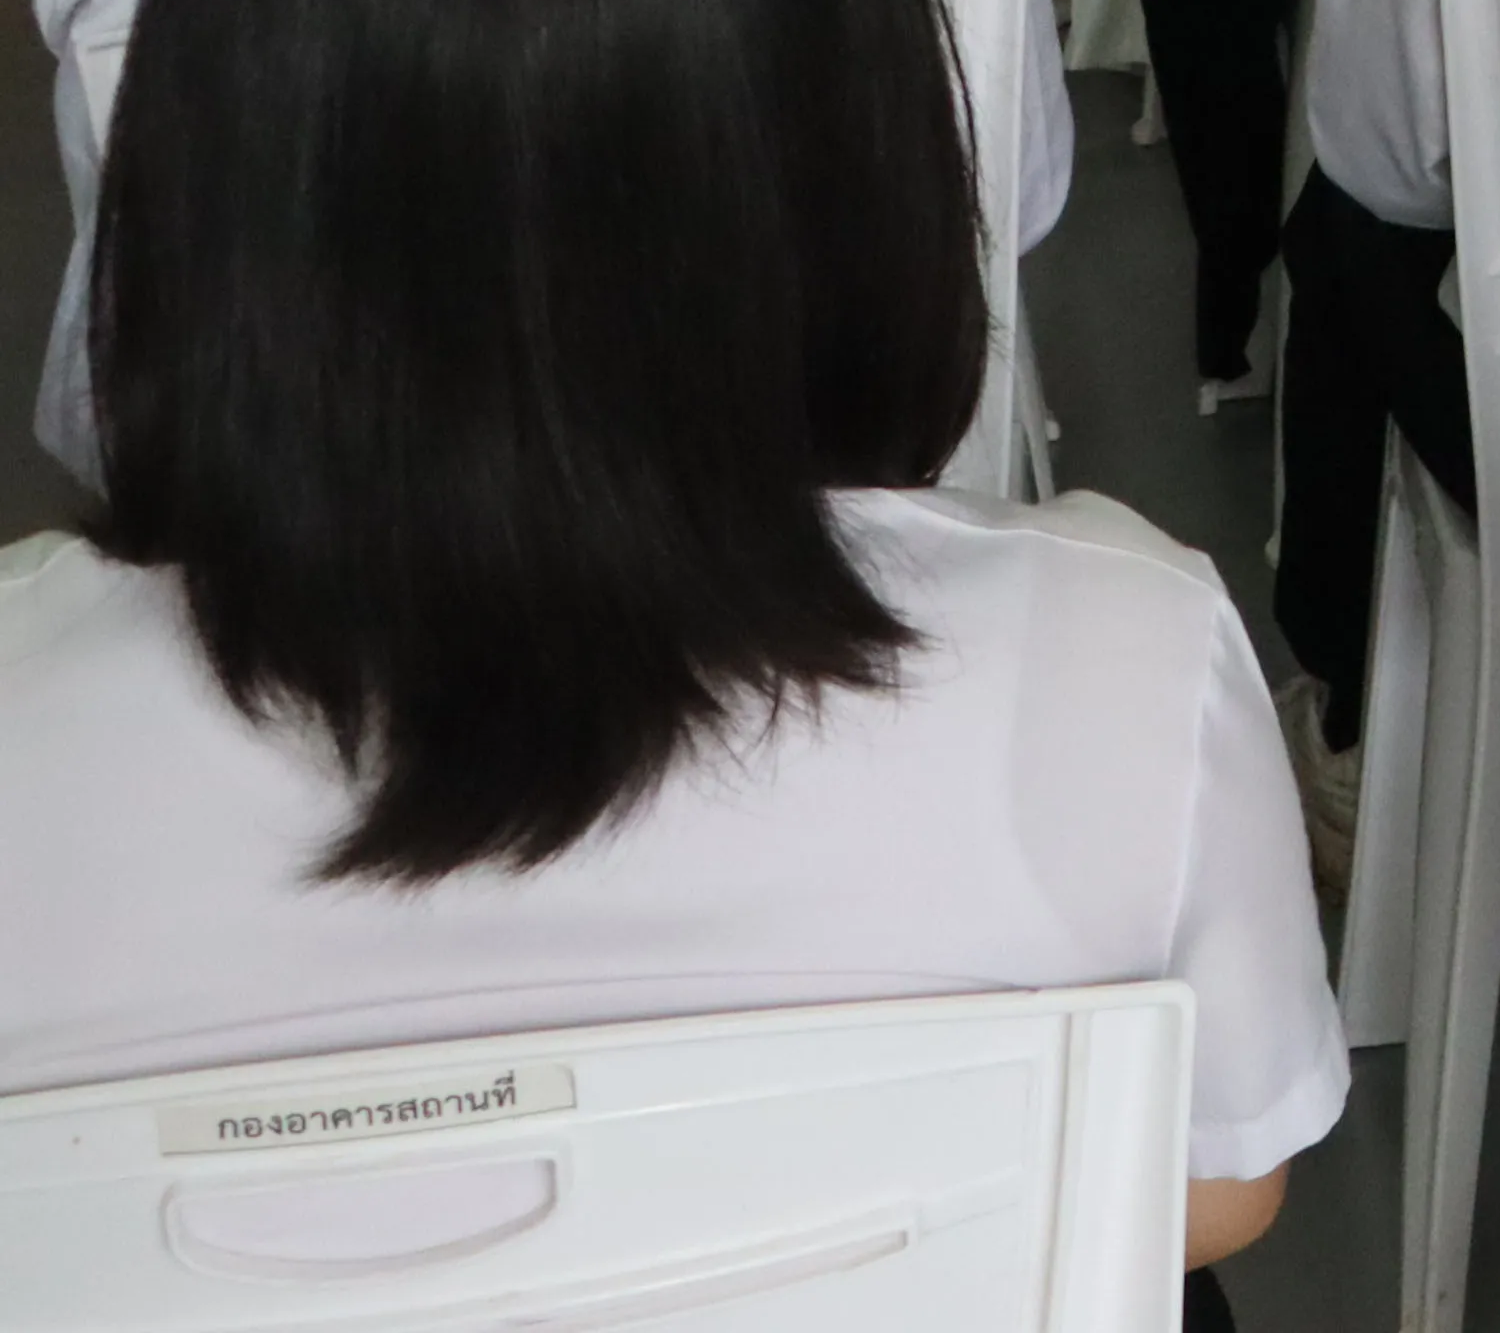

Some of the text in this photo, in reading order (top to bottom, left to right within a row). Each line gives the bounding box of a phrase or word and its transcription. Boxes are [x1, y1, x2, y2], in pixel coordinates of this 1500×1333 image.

[215, 1069, 519, 1142] กองอาคารสถานที่
